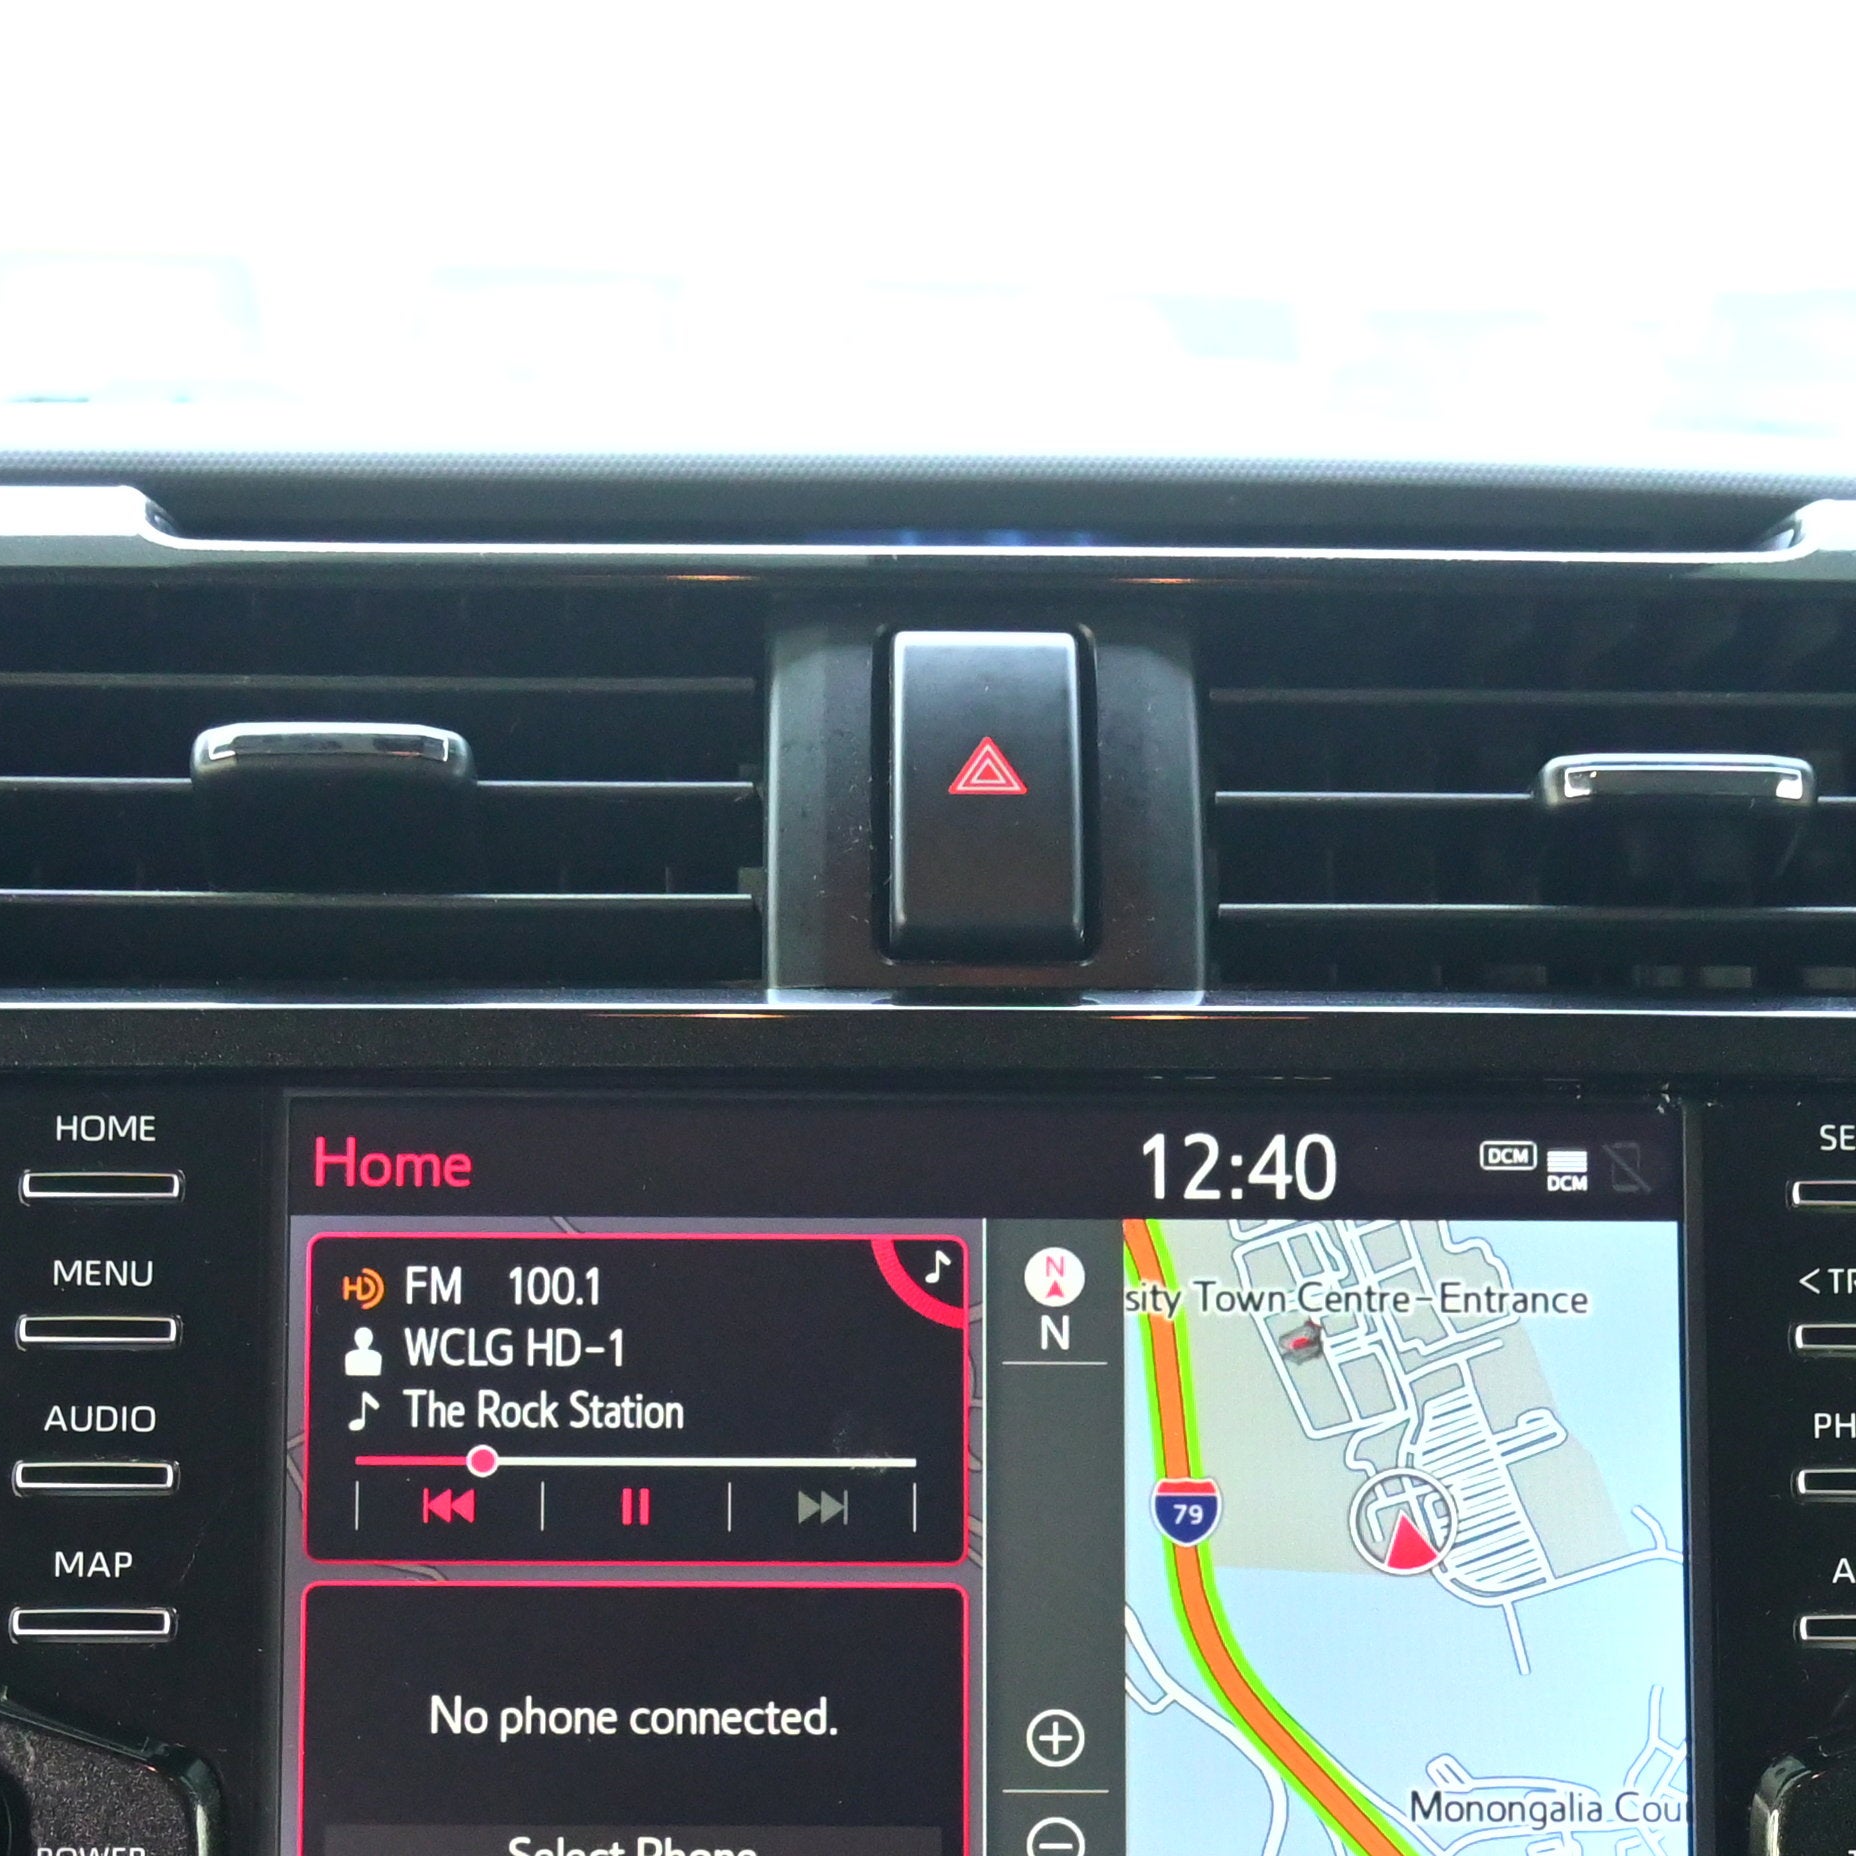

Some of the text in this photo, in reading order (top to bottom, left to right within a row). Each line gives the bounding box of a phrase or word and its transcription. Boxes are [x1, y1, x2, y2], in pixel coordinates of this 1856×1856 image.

[56, 1115, 156, 1142] HOME
[314, 1136, 473, 1188] Home
[1142, 1132, 1337, 1201] 12:40
[1487, 1147, 1529, 1165] DCM
[1546, 1174, 1588, 1192] DCM
[53, 1259, 153, 1287] MENU
[405, 1265, 462, 1305] FM
[509, 1266, 599, 1306] 100.1
[1126, 1281, 1181, 1319] sity
[1193, 1280, 1287, 1313] Town
[404, 1327, 623, 1367] WCLG HD-1
[1040, 1314, 1070, 1351] N
[43, 1405, 156, 1433] AUDIO
[402, 1388, 684, 1430] The Rock Station
[1173, 1503, 1204, 1525] 79
[54, 1551, 133, 1578] MAP
[430, 1694, 838, 1743] No phone connected.
[1411, 1791, 1681, 1828] Monongalia Cou
